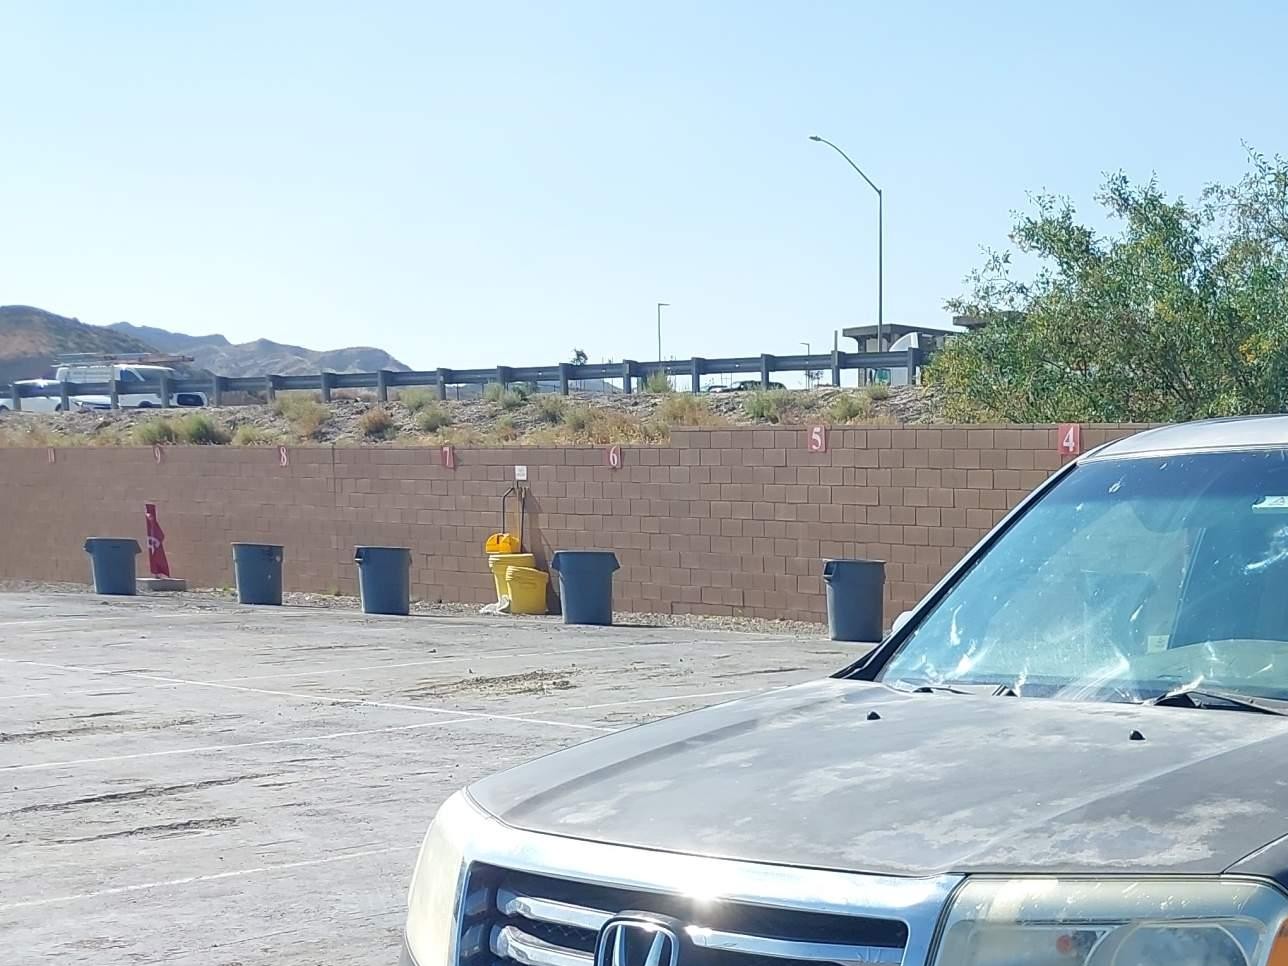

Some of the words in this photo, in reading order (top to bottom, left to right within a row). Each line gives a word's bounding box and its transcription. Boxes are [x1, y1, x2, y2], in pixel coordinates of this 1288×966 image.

[811, 426, 822, 450] 5
[1063, 425, 1075, 452] 4
[279, 446, 288, 467] 8
[609, 445, 618, 467] 6
